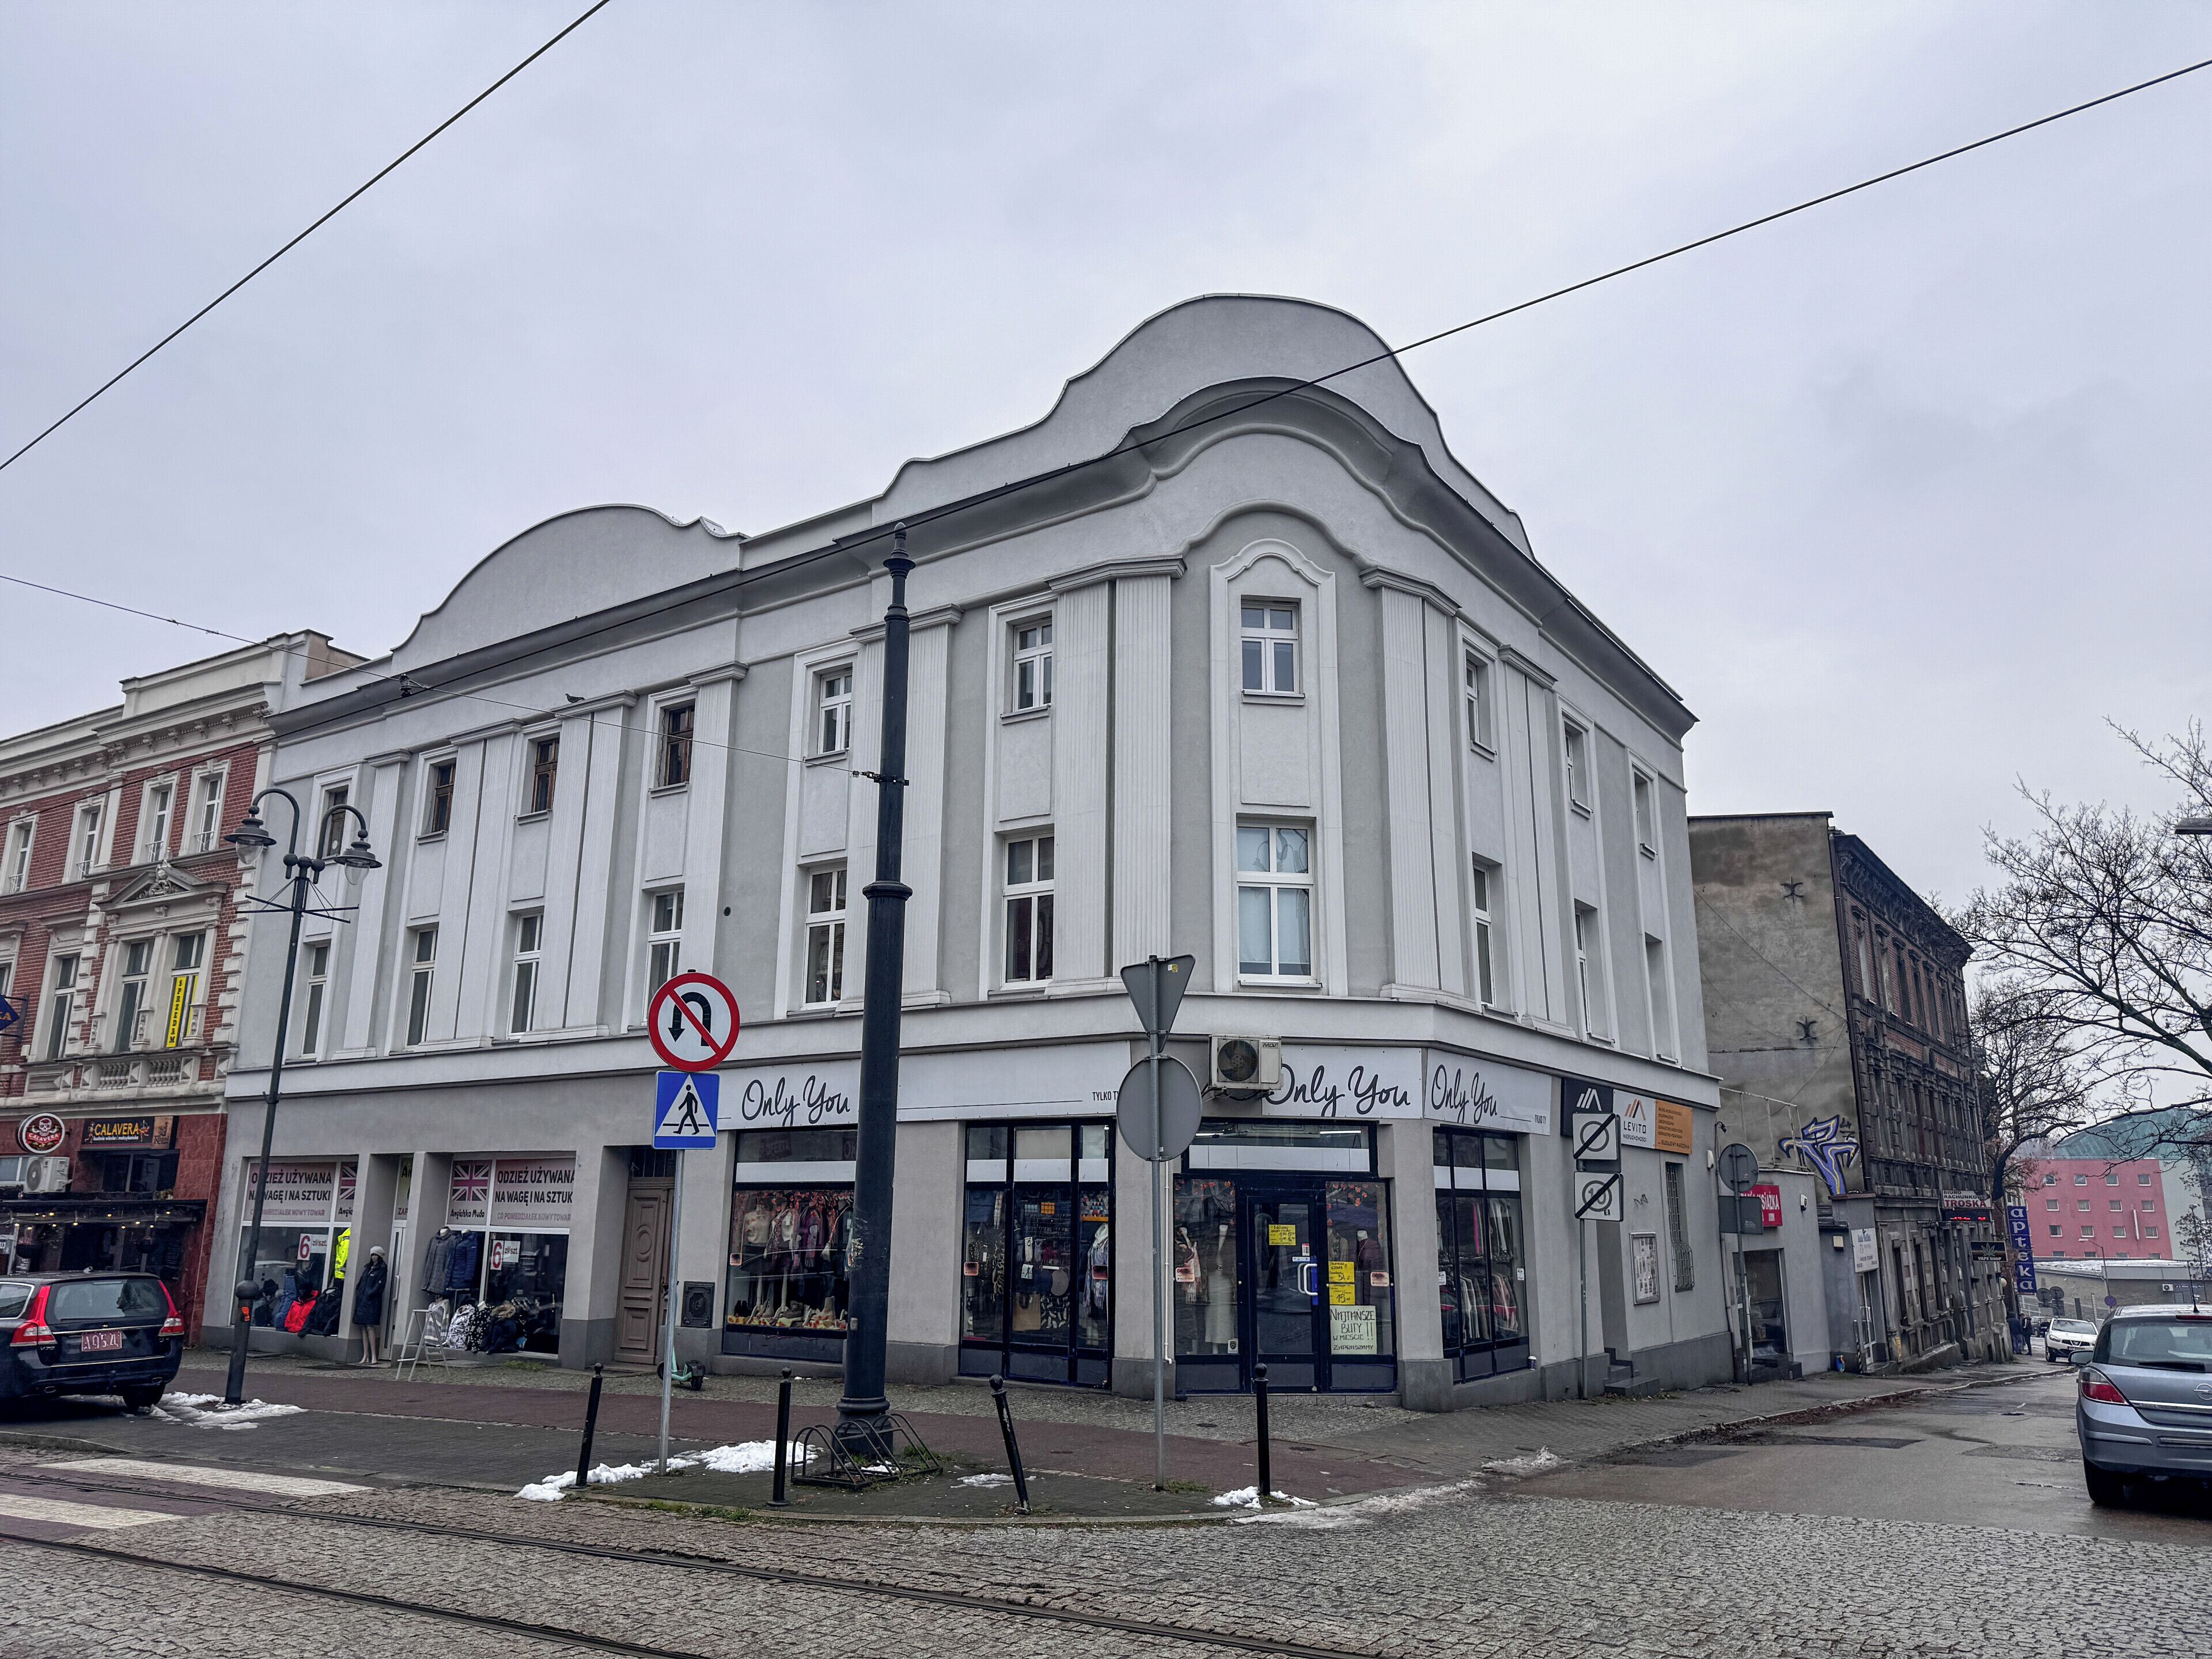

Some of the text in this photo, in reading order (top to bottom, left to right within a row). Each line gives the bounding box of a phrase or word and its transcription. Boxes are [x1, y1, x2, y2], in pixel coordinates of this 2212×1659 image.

[169, 980, 182, 1043] SPRZEDAM
[1092, 1091, 1112, 1101] TYLKO
[1348, 1066, 1410, 1115] You
[1431, 1065, 1497, 1124] Only You
[742, 1075, 850, 1126] Only You
[94, 1123, 139, 1136] CALAVERA
[1623, 1120, 1646, 1134] LEVITO
[28, 1132, 59, 1142] CALAVERA
[252, 1169, 332, 1184] OZIEŻ UŻYWANA
[498, 1166, 528, 1184] ODZIEŻ
[289, 1190, 300, 1200] NA
[301, 1190, 331, 1200] SZTUKI
[495, 1191, 505, 1202] NA
[507, 1191, 529, 1206] WAGĘ
[534, 1191, 545, 1203] NA
[300, 1235, 310, 1259] 6
[2010, 1209, 2033, 1290] apteka
[493, 1242, 502, 1268] 6
[1330, 1308, 1375, 1323] NAJTAŃSZE
[1341, 1323, 1362, 1334] BUTY
